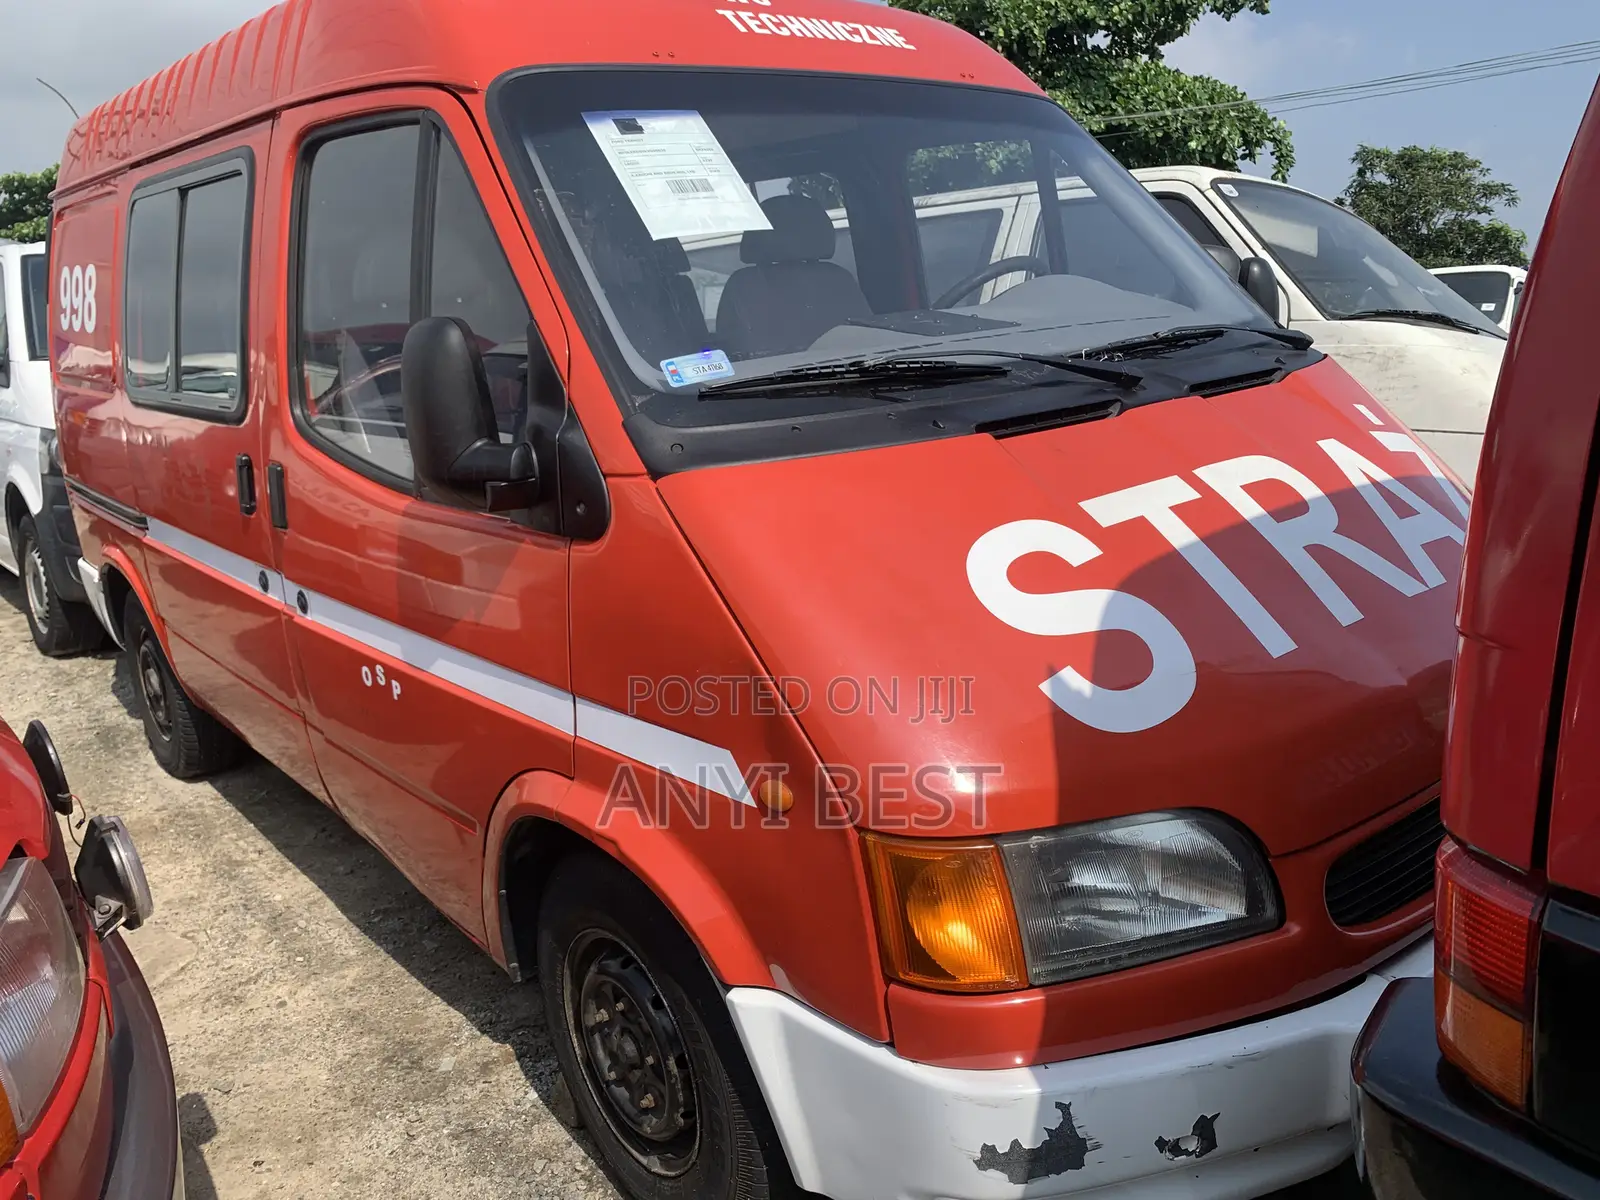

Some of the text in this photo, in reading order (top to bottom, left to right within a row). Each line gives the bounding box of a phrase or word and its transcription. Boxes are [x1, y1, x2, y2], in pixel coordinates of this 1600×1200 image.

[715, 9, 917, 50] TECHNICZNE
[60, 263, 97, 334] 998
[692, 366, 707, 375] STA
